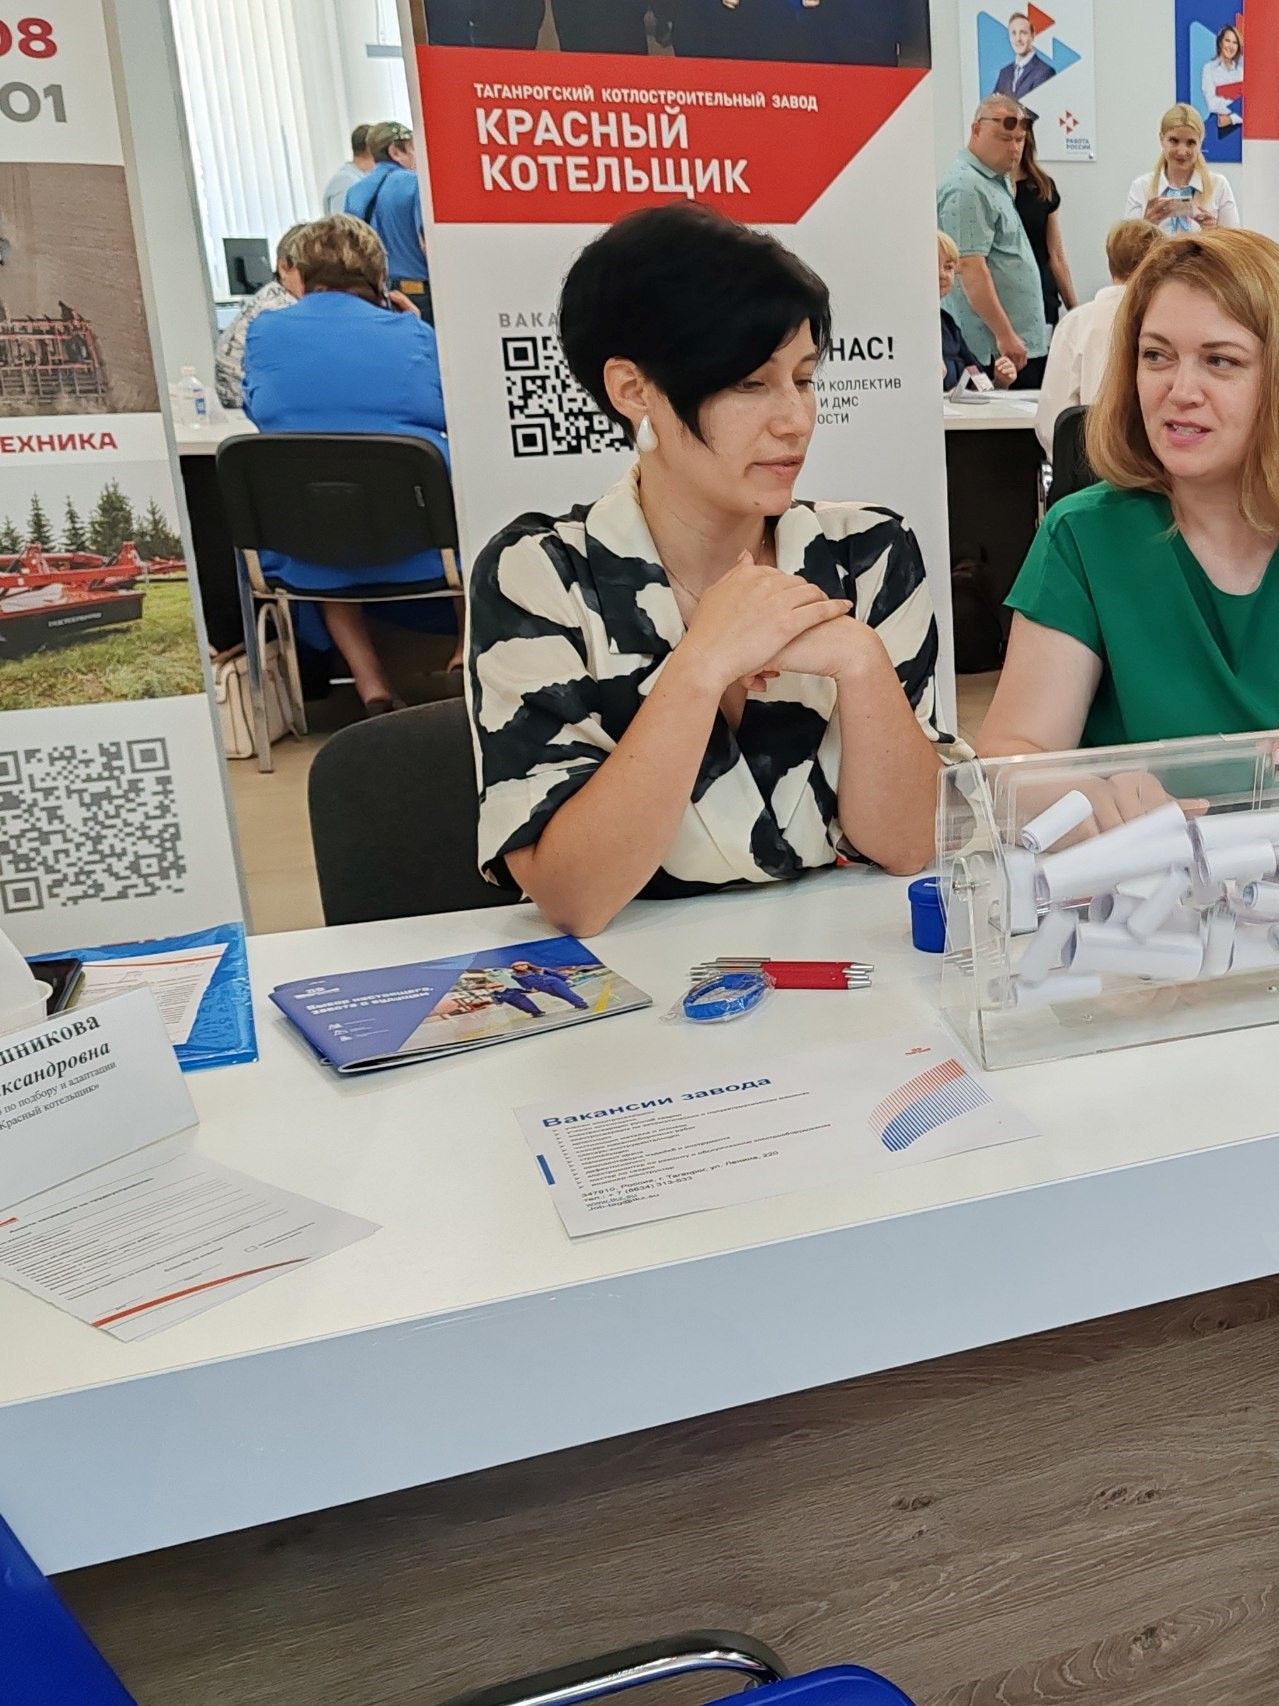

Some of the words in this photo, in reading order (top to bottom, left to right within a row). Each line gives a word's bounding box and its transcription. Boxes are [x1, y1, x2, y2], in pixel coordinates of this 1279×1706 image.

[473, 83, 594, 102] ТАГАНРОГСКИЙ
[601, 88, 765, 108] КОТЛОСТРОИТЕЛЬНЫЙ
[771, 95, 818, 112] ЗАВОД
[475, 106, 688, 149] КРАСНЫЙ
[481, 154, 750, 200] КОТЕЛЬЩИК
[829, 336, 894, 361] НАС!
[829, 378, 902, 391] КОЛЛЕКТИВ
[832, 396, 859, 409] ДМС
[0, 432, 118, 454] ЕХНИКА
[0, 1042, 111, 1096] ксандровна
[4, 1102, 17, 1114] по
[18, 1084, 58, 1108] подбору
[60, 1082, 67, 1090] и
[69, 1062, 117, 1087] адаптации
[542, 1096, 673, 1128] Вакансии
[681, 1077, 771, 1101] завода
